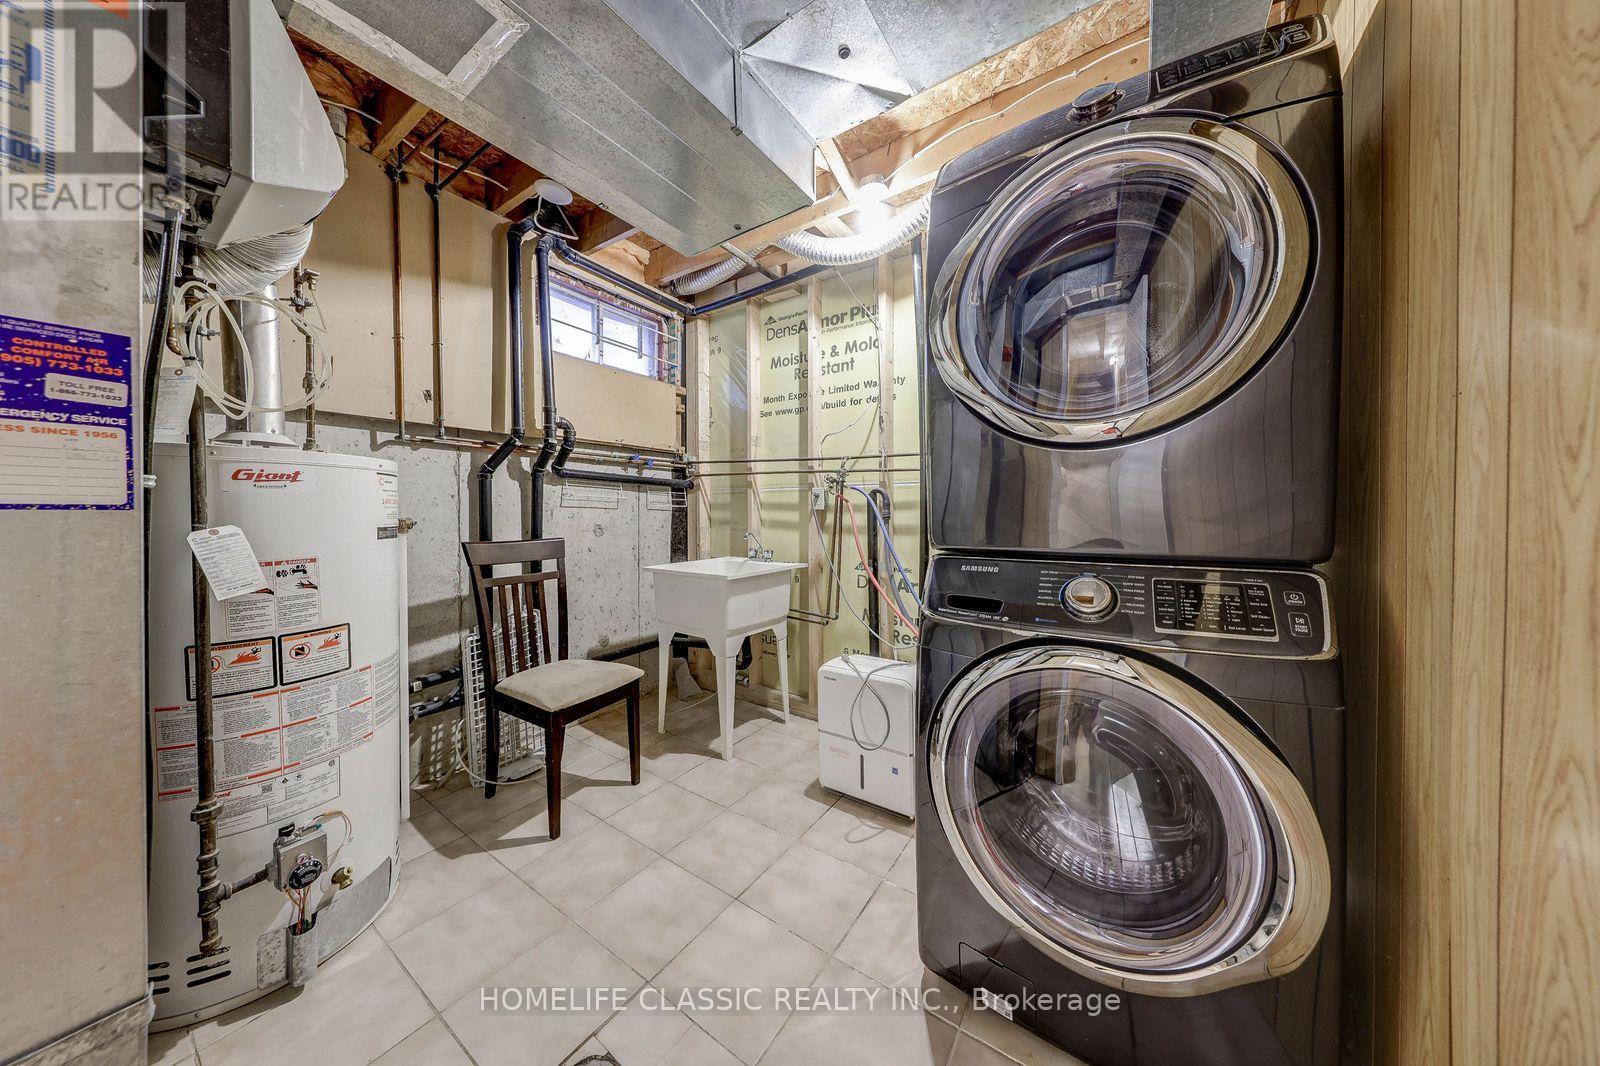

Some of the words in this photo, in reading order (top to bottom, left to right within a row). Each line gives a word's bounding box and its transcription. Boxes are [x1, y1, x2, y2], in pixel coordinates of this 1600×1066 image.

[766, 312, 848, 341] DensAmor
[10, 346, 82, 361] COMFORT
[85, 356, 109, 365] AIR
[11, 337, 108, 357] CONTROLLED
[0, 353, 42, 367] 905)
[46, 358, 124, 377] 773-1033
[770, 349, 826, 370] Moistue
[830, 345, 840, 357] &
[794, 357, 855, 380] Restant
[58, 380, 85, 390] TOLL
[88, 385, 116, 394] FREE
[763, 394, 786, 404] Month
[828, 381, 860, 394] Limited
[863, 375, 906, 389] Wanty
[760, 410, 772, 418] See
[775, 401, 847, 415] www.gp./build
[850, 397, 862, 406] for
[71, 413, 128, 426] SERVICE
[30, 426, 79, 437] SINCE
[84, 430, 119, 440] 1956
[231, 468, 304, 483] Giant
[961, 564, 999, 573] SAMSUNG
